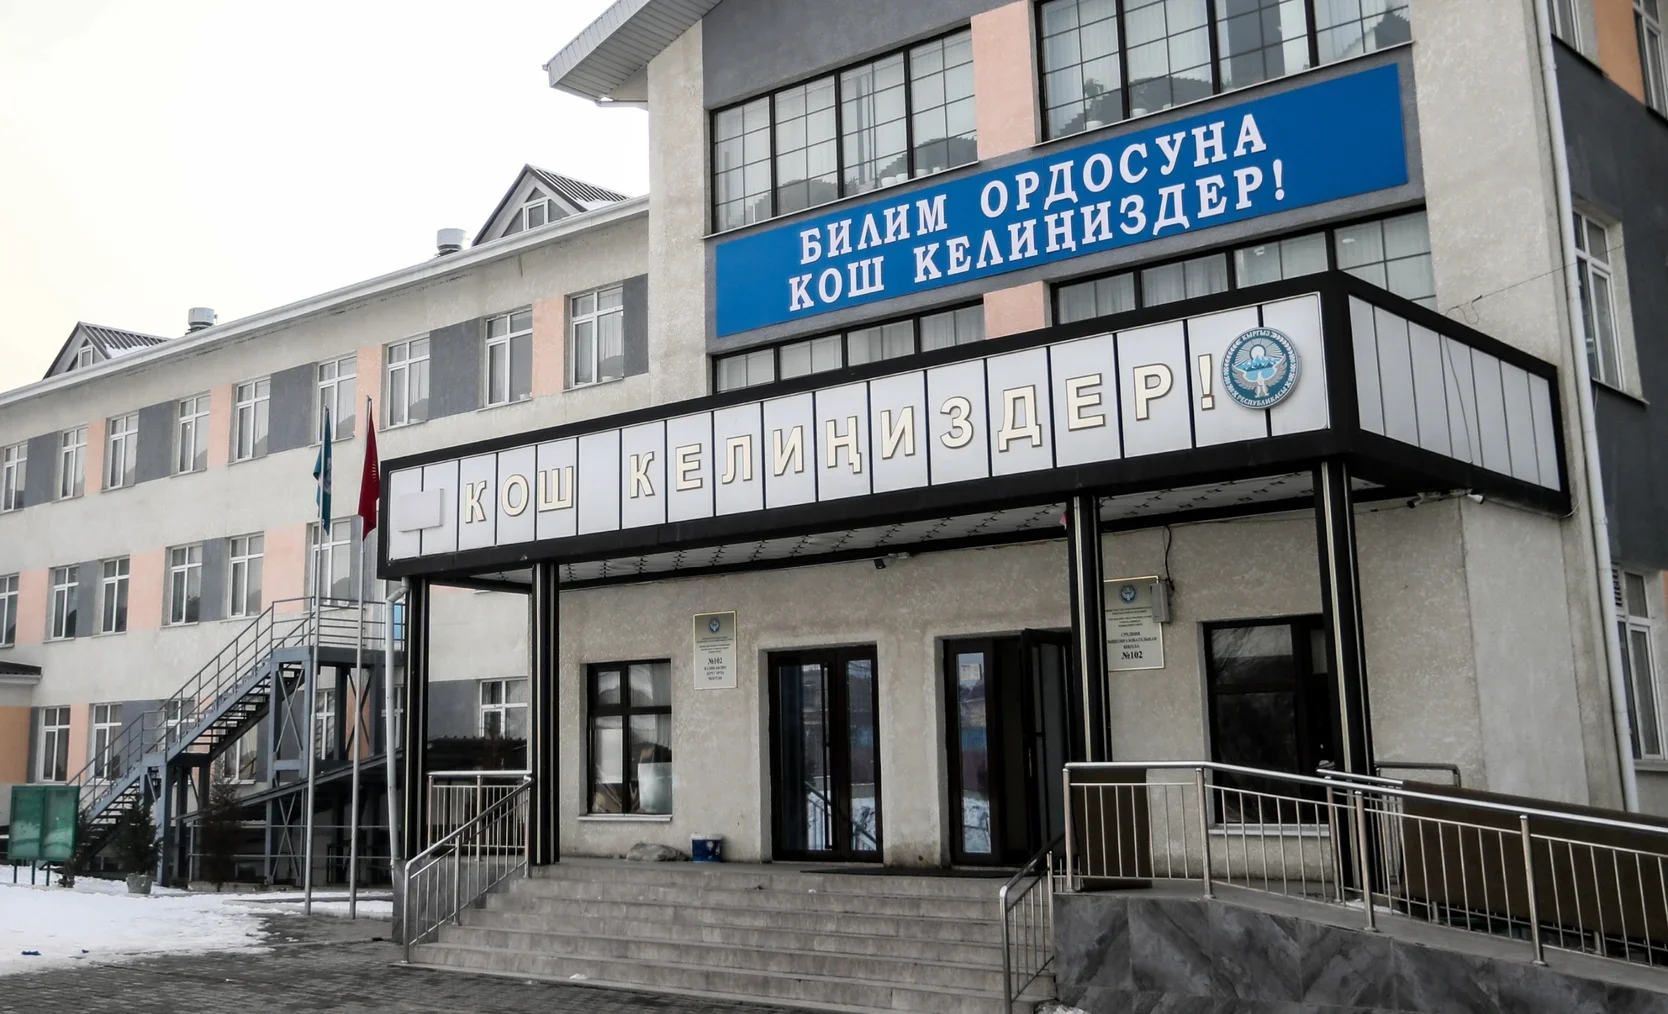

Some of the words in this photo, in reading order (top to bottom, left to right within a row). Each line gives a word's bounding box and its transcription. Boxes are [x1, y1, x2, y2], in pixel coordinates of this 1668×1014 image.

[800, 194, 948, 265] БИЛИМ
[980, 113, 1267, 218] ОРДОСУНА
[789, 256, 884, 312] КОШ
[913, 159, 1285, 283] КЕЛИҢИЗДЕР!
[1241, 329, 1271, 341] КЫРГЫЗ
[465, 466, 575, 524] КОШ
[629, 353, 1215, 499] КЕЛИҢИЗДЕР!
[1236, 386, 1290, 407] РЕСПУБЛИКАСЫ
[1121, 650, 1143, 660] №102
